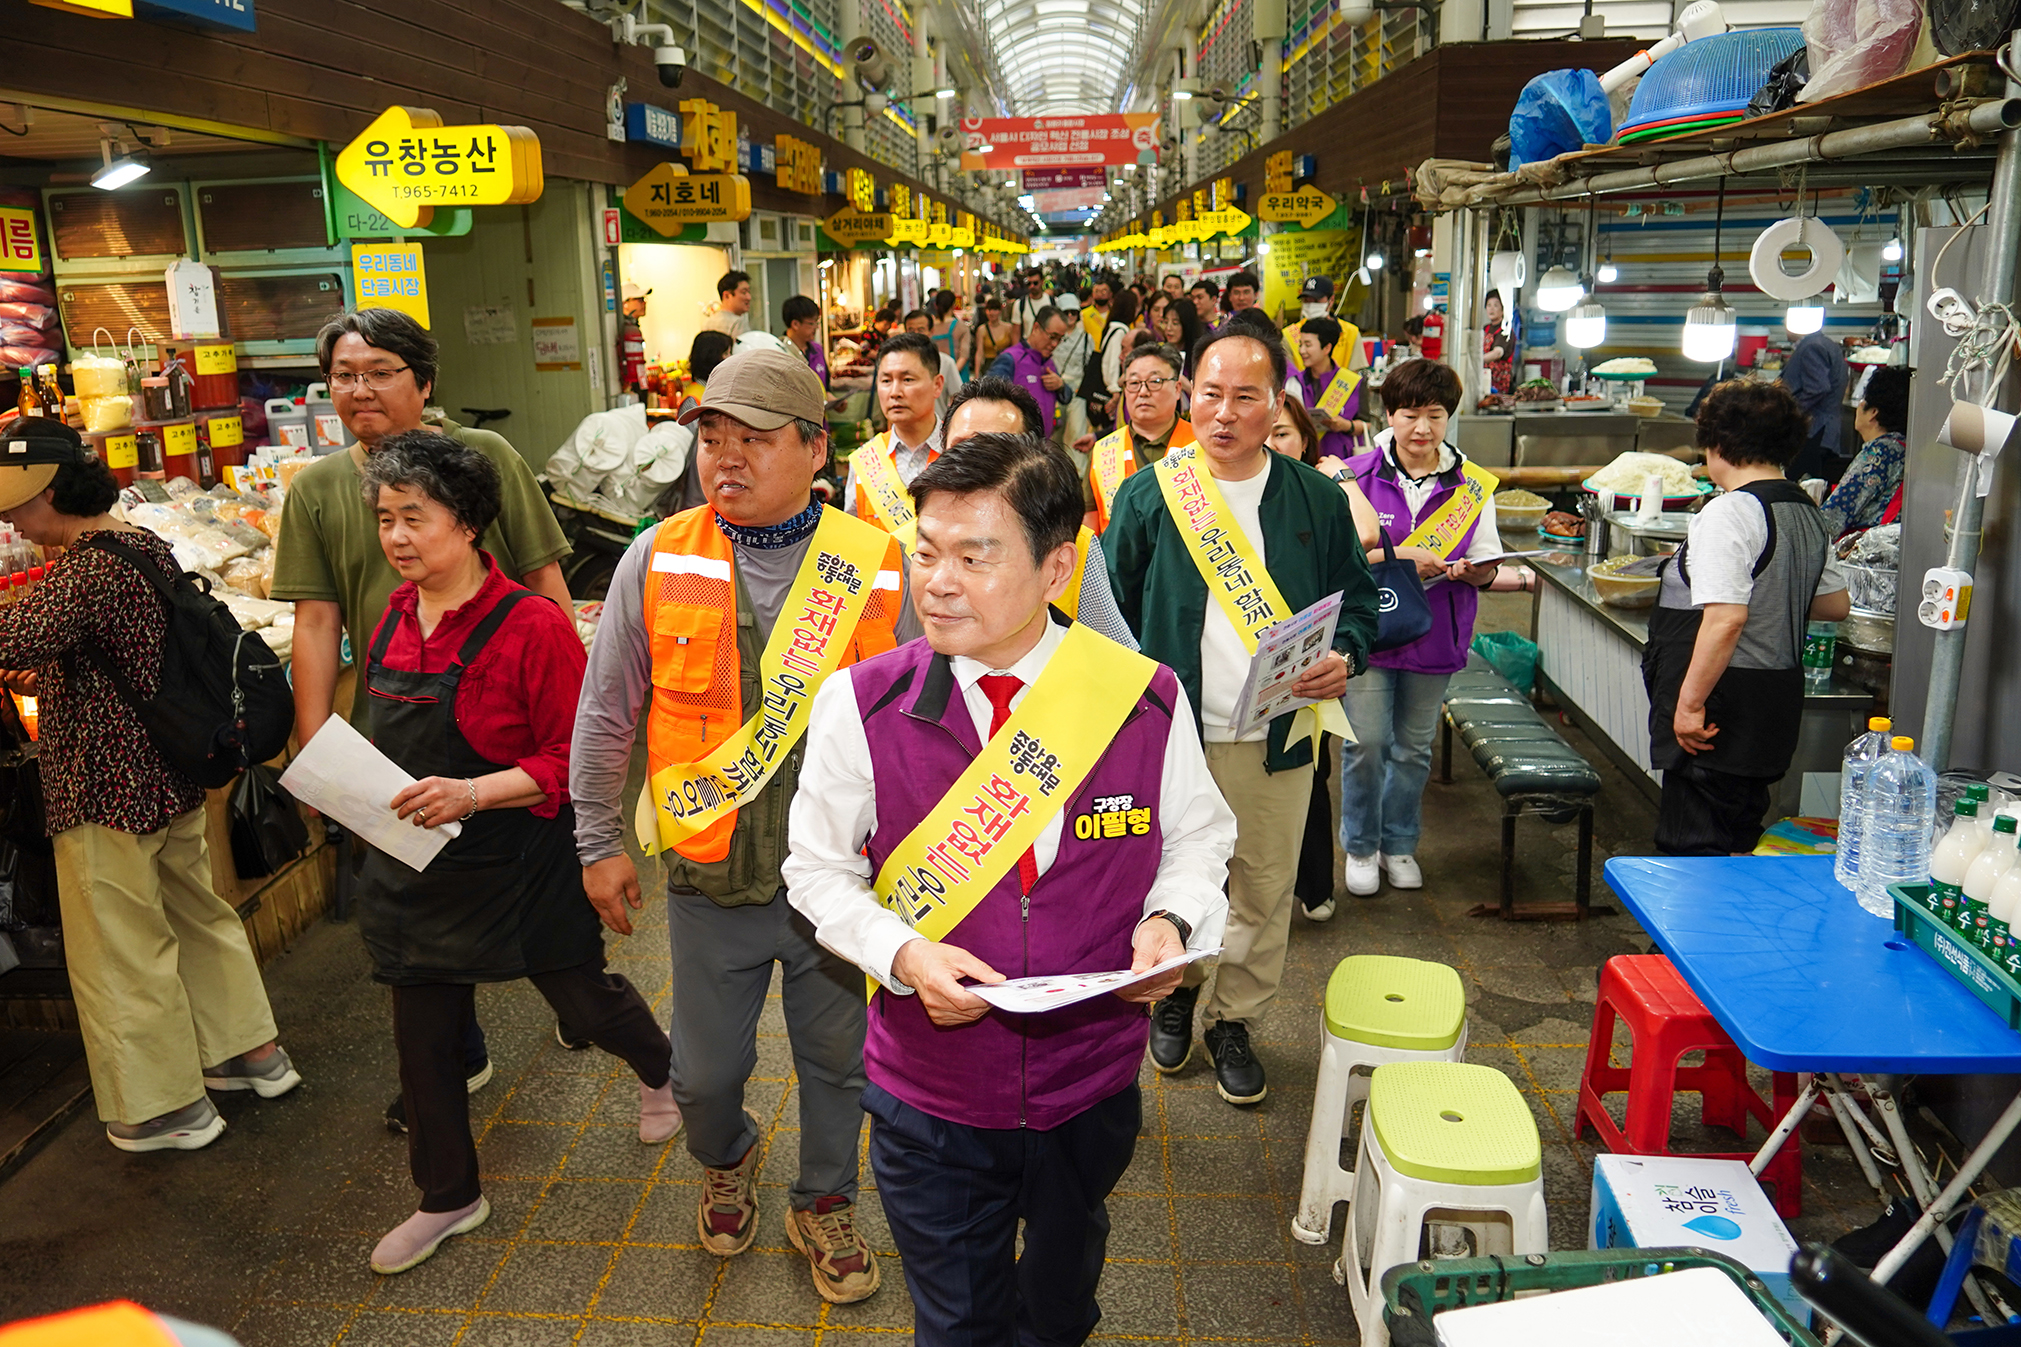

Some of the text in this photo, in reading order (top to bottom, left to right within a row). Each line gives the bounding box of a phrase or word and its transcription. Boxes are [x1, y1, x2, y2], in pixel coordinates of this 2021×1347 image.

[364, 136, 497, 177] 유창농산
[392, 184, 478, 199] T.965-7412
[651, 181, 721, 205] 지호네
[1267, 196, 1324, 211] 우리약국
[347, 213, 389, 231] 다-22
[359, 254, 418, 273] 우리동네
[361, 278, 420, 297] 단골시장
[1171, 464, 1217, 532] 화재없는
[1435, 493, 1473, 543] 화재없는
[1199, 527, 1275, 627] 우리동네 함께
[782, 587, 848, 677] 화재없는
[754, 672, 808, 764] 우리동네
[1093, 795, 1135, 813] 구청장
[925, 773, 1033, 886] 화재없는
[1075, 808, 1152, 842] 이필형
[1716, 1189, 1747, 1216] fresh
